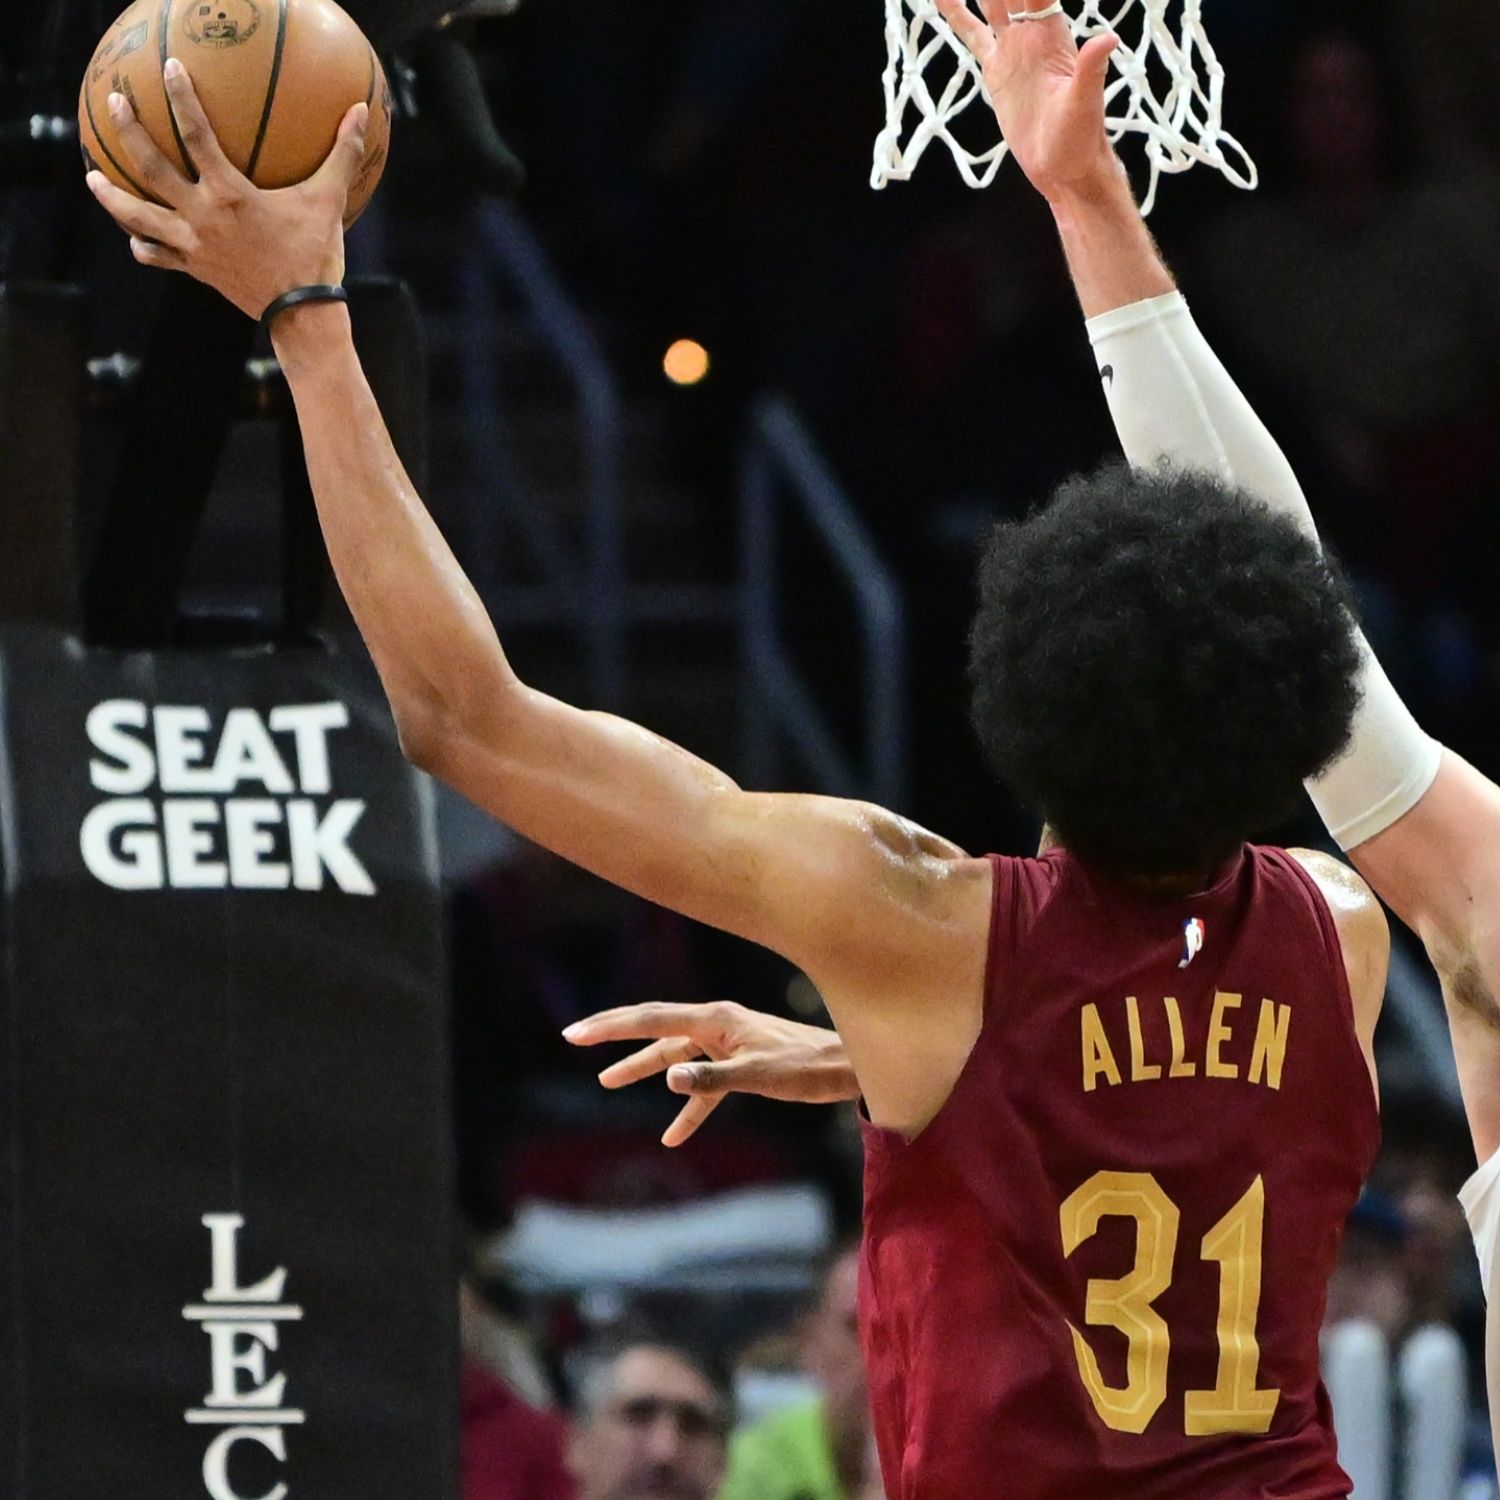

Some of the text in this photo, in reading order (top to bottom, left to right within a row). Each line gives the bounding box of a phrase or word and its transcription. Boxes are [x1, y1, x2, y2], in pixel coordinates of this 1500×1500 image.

[85, 699, 349, 795] SEAT
[80, 798, 376, 896] GEEK
[1081, 991, 1292, 1092] ALLEN
[1059, 1170, 1282, 1436] 31
